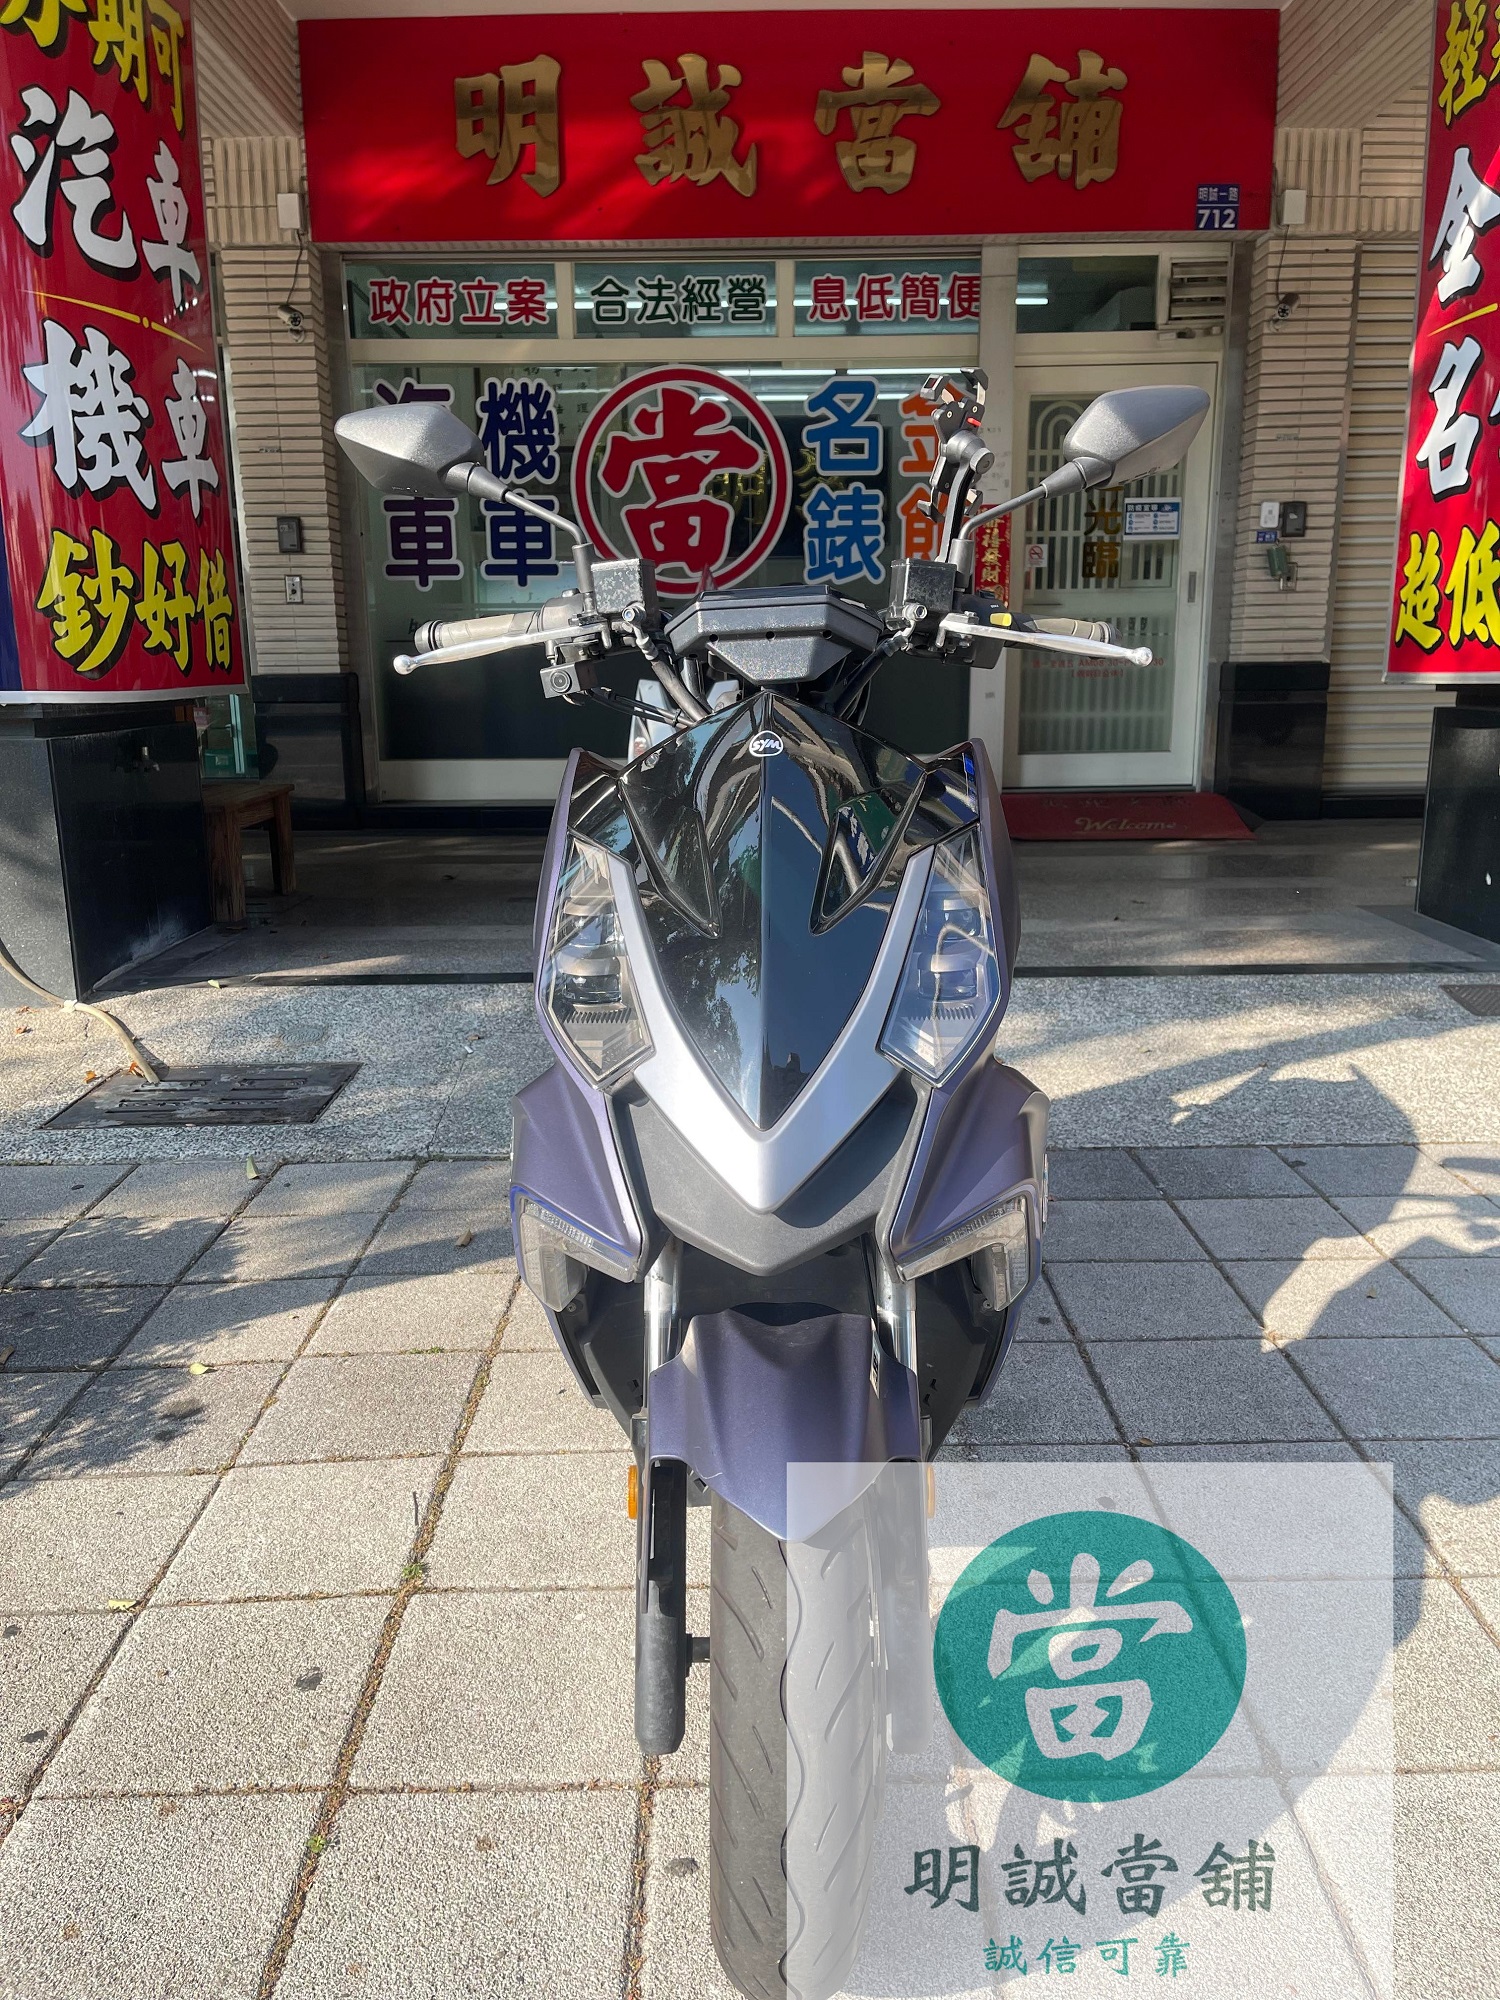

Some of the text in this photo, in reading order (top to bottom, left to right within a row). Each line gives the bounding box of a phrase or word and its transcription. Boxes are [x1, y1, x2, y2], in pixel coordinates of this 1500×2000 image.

[1438, 0, 1500, 126] 輕
[10, 87, 200, 308] 汽車
[1198, 187, 1239, 201] 明誠一路
[1198, 208, 1236, 229] 712
[367, 276, 549, 326] 政府立案
[590, 275, 767, 325] 合法經營
[808, 273, 981, 322] 息低簡便
[21, 319, 218, 518] 機車
[1415, 336, 1500, 496] 名
[602, 387, 760, 573] 當
[803, 378, 885, 583] 名錶
[1082, 486, 1123, 578] 光臨
[37, 529, 233, 672] 鈔好借
[752, 739, 781, 751] SYM
